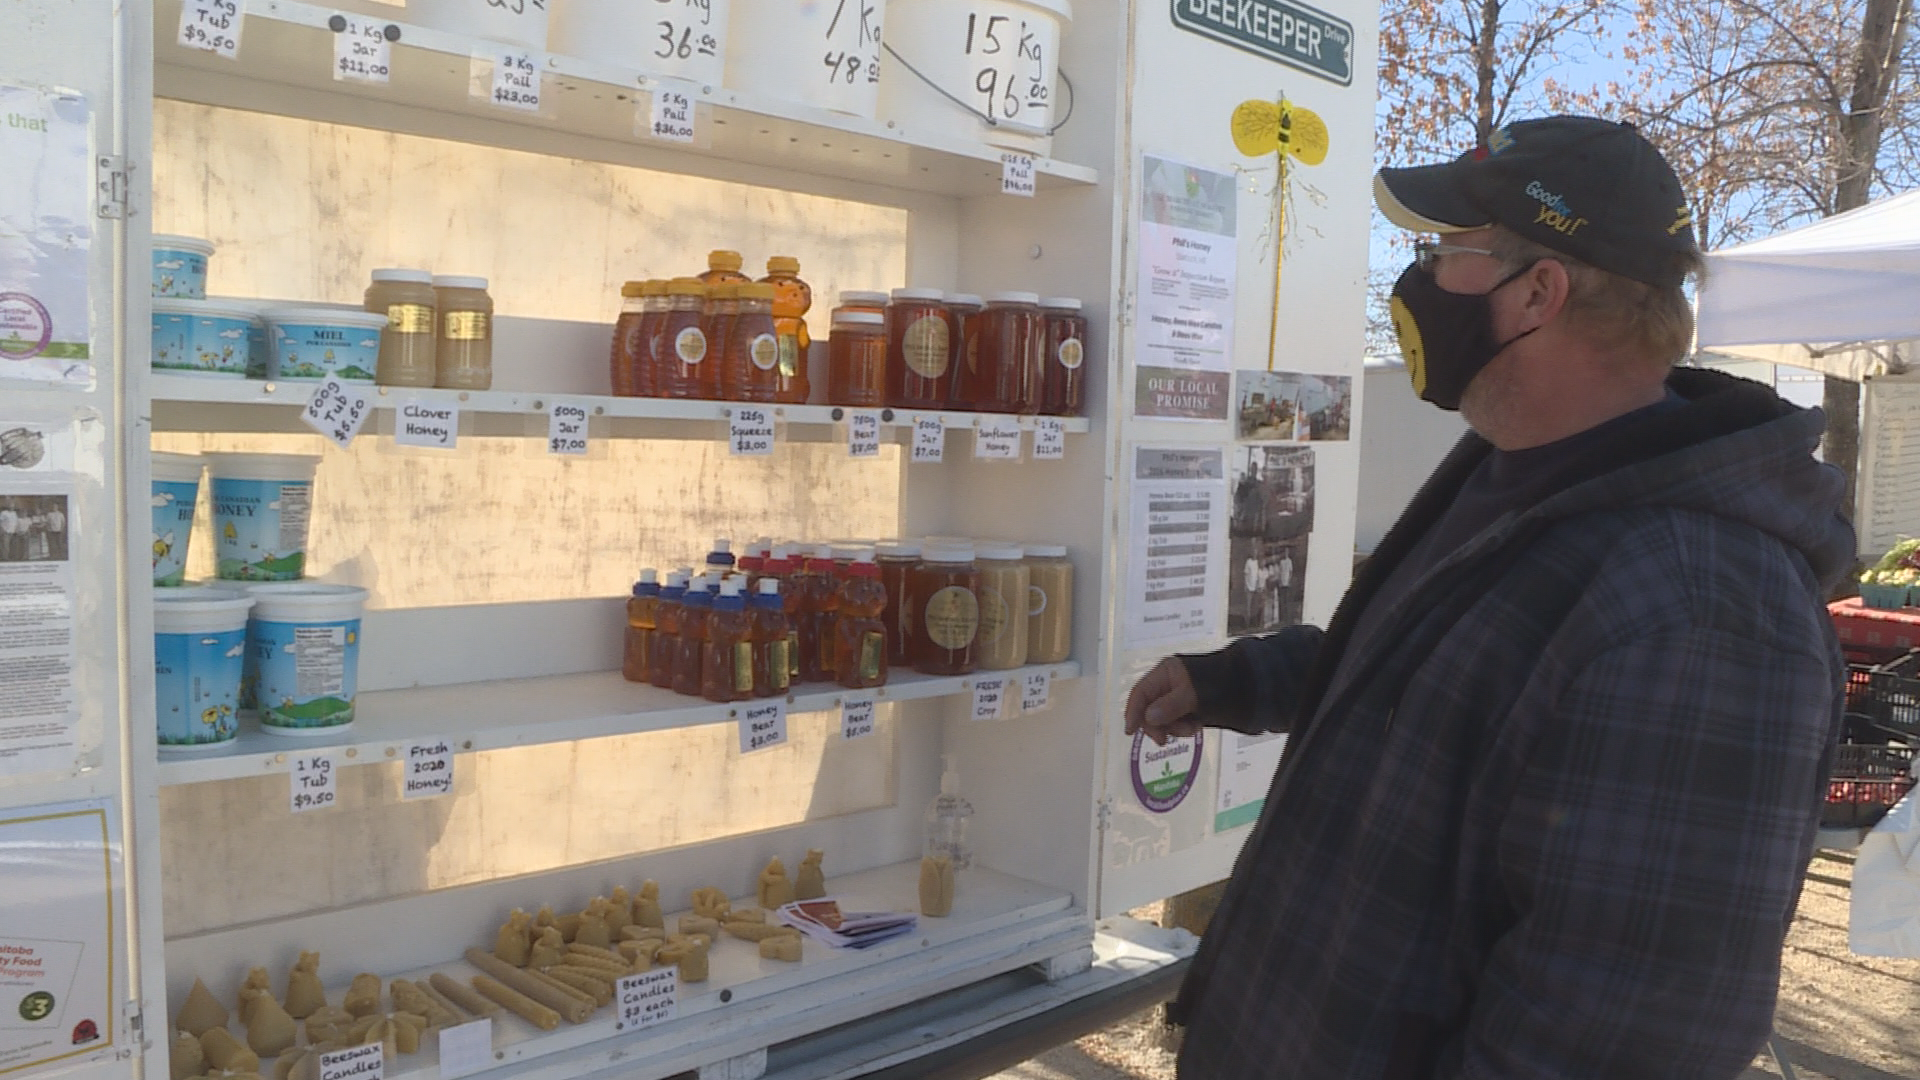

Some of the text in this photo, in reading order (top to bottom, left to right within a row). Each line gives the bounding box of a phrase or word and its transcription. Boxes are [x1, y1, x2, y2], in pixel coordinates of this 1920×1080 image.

[197, 9, 230, 29] Tub
[185, 24, 235, 50] $9.50
[349, 23, 383, 44] 1 Kg
[965, 13, 1010, 54] 15
[1324, 24, 1347, 46] Drive
[353, 42, 378, 56] Jar
[339, 57, 389, 75] $11.00
[503, 55, 534, 76] 3 Kg
[504, 72, 531, 88] Pail
[495, 87, 538, 104] $23.00
[662, 92, 688, 110] 5 Kg
[663, 107, 687, 121] Pail
[8, 113, 48, 133] that
[654, 121, 693, 137] $36.00
[1525, 181, 1564, 207] Good
[313, 330, 344, 341] MIEL
[1148, 378, 1219, 396] OUR LOCAL
[309, 381, 340, 419] 500g
[1156, 394, 1211, 410] PROMISE
[324, 395, 347, 422] Tub
[403, 405, 452, 420] Clover
[554, 406, 585, 421] 500g
[334, 399, 365, 441] $5.50
[740, 410, 764, 425] 225g
[406, 423, 448, 443] Honey
[559, 422, 580, 434] Jar
[731, 425, 772, 442] Squeeze
[854, 429, 876, 440] Bear
[919, 420, 942, 435] 500g
[979, 426, 1019, 441] Sunflower
[551, 437, 586, 452] $7.00
[921, 433, 938, 444] Jar
[1043, 432, 1057, 442] Jar
[737, 440, 767, 453] $3.00
[915, 445, 941, 458] $7.00
[985, 442, 1010, 455] Honey
[1029, 687, 1042, 697] Jar
[746, 705, 777, 720] Honey
[844, 700, 872, 712] Honey
[977, 706, 997, 719] Crop
[751, 720, 775, 733] Bear
[848, 713, 869, 724] Bear
[750, 731, 779, 749] $3.00
[410, 742, 449, 758] Fresh
[1145, 743, 1189, 764] Sustainable
[298, 757, 331, 774] 1 Kg
[414, 759, 446, 774] 2020
[300, 773, 327, 788] Tub
[407, 773, 453, 793] Honey!
[294, 791, 334, 810] $9.50
[13, 956, 42, 967] Food
[622, 970, 674, 991] Beeswax
[623, 984, 675, 1005] Candles
[645, 997, 674, 1013] each
[322, 1044, 381, 1067] Beeswax
[322, 1060, 381, 1080] Candles
